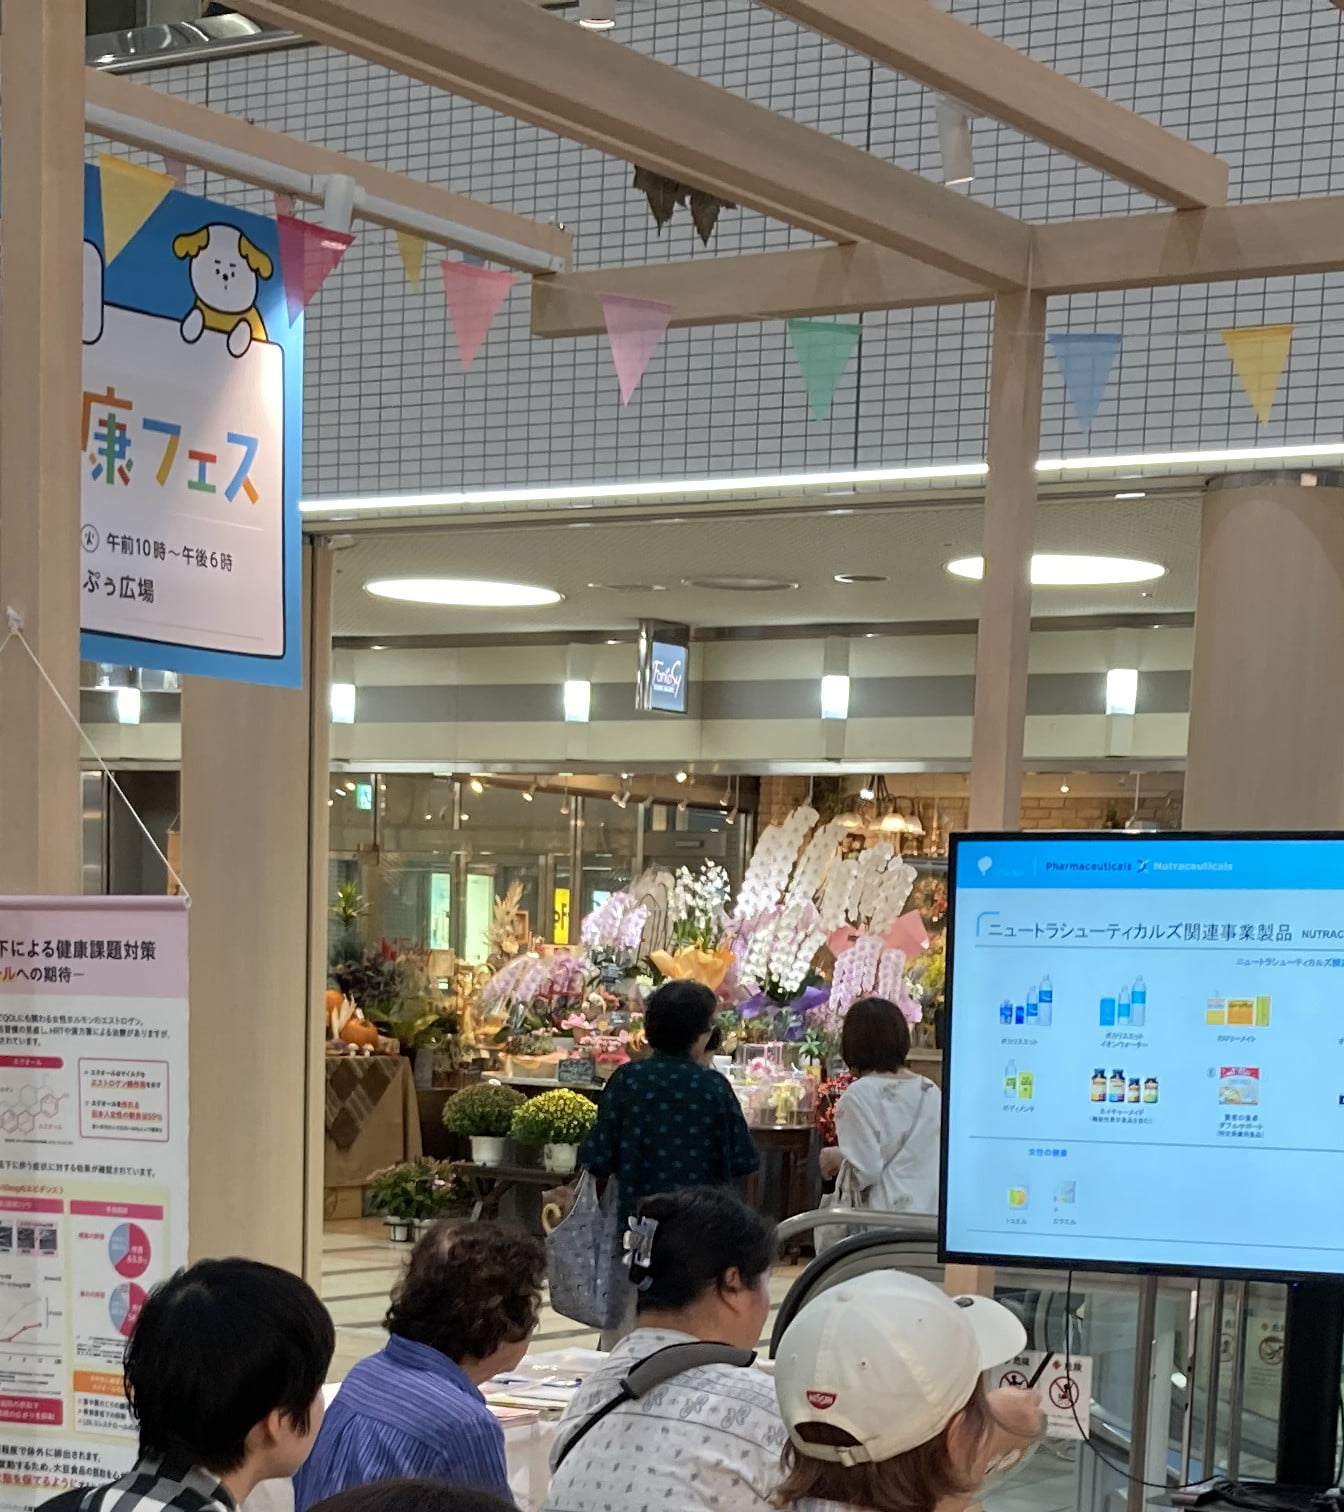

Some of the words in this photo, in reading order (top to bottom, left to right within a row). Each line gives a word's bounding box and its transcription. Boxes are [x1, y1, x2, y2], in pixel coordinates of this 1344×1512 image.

[1045, 860, 1133, 872] Pharmaceuticals
[1153, 861, 1234, 872] Nutraceuticals
[988, 921, 1293, 943] ニュートラシューティカルズ関連事業製品
